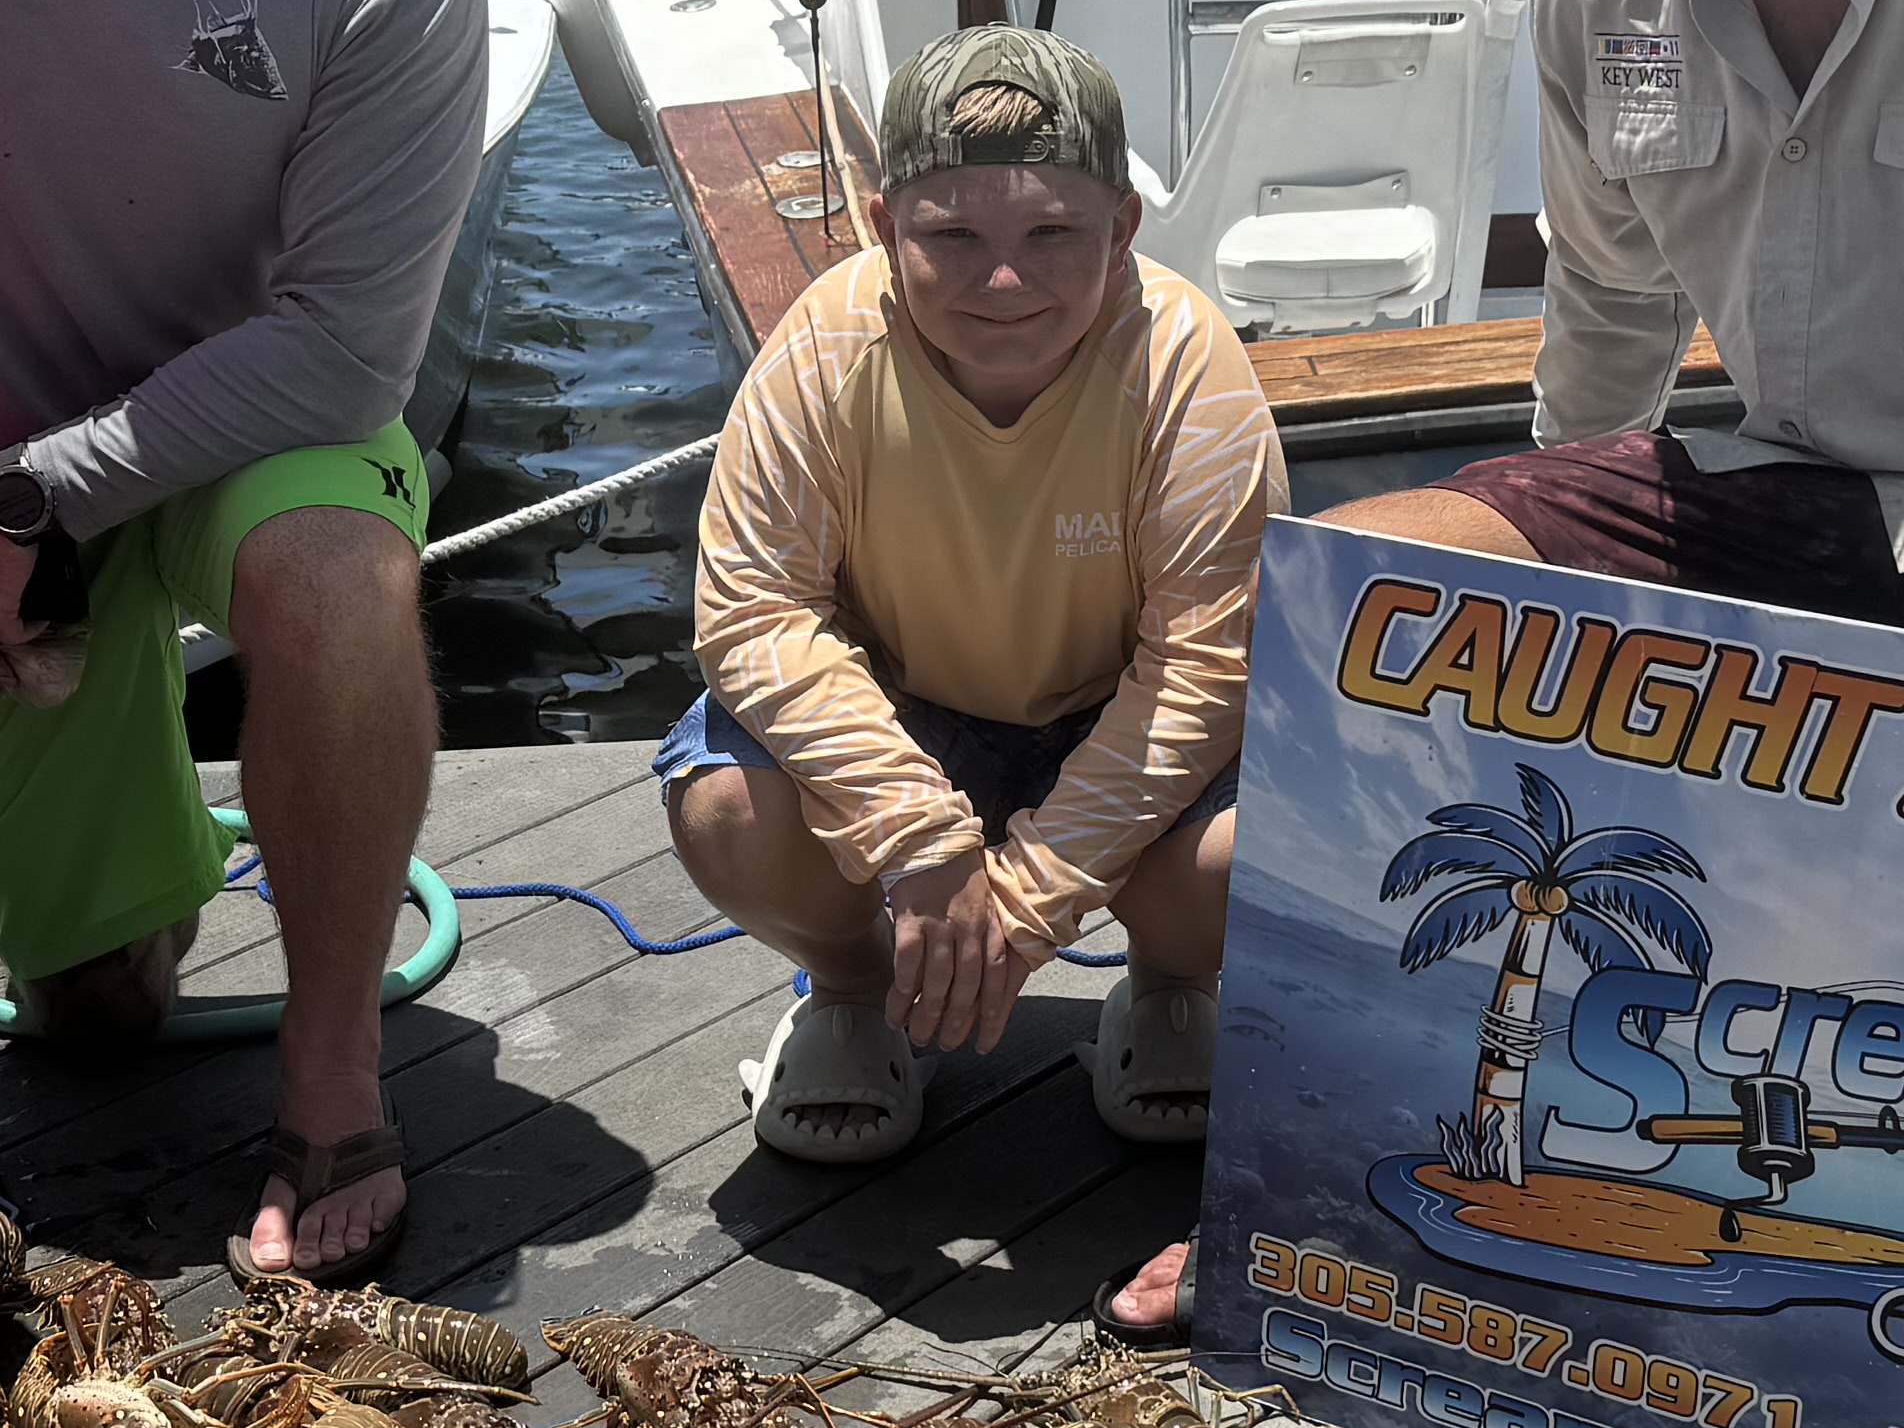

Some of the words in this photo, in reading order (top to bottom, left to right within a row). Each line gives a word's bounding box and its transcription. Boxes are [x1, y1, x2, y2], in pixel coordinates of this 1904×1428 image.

[1601, 65, 1633, 88] KEY
[1638, 68, 1683, 89] WEST
[1055, 539, 1123, 558] PELICA
